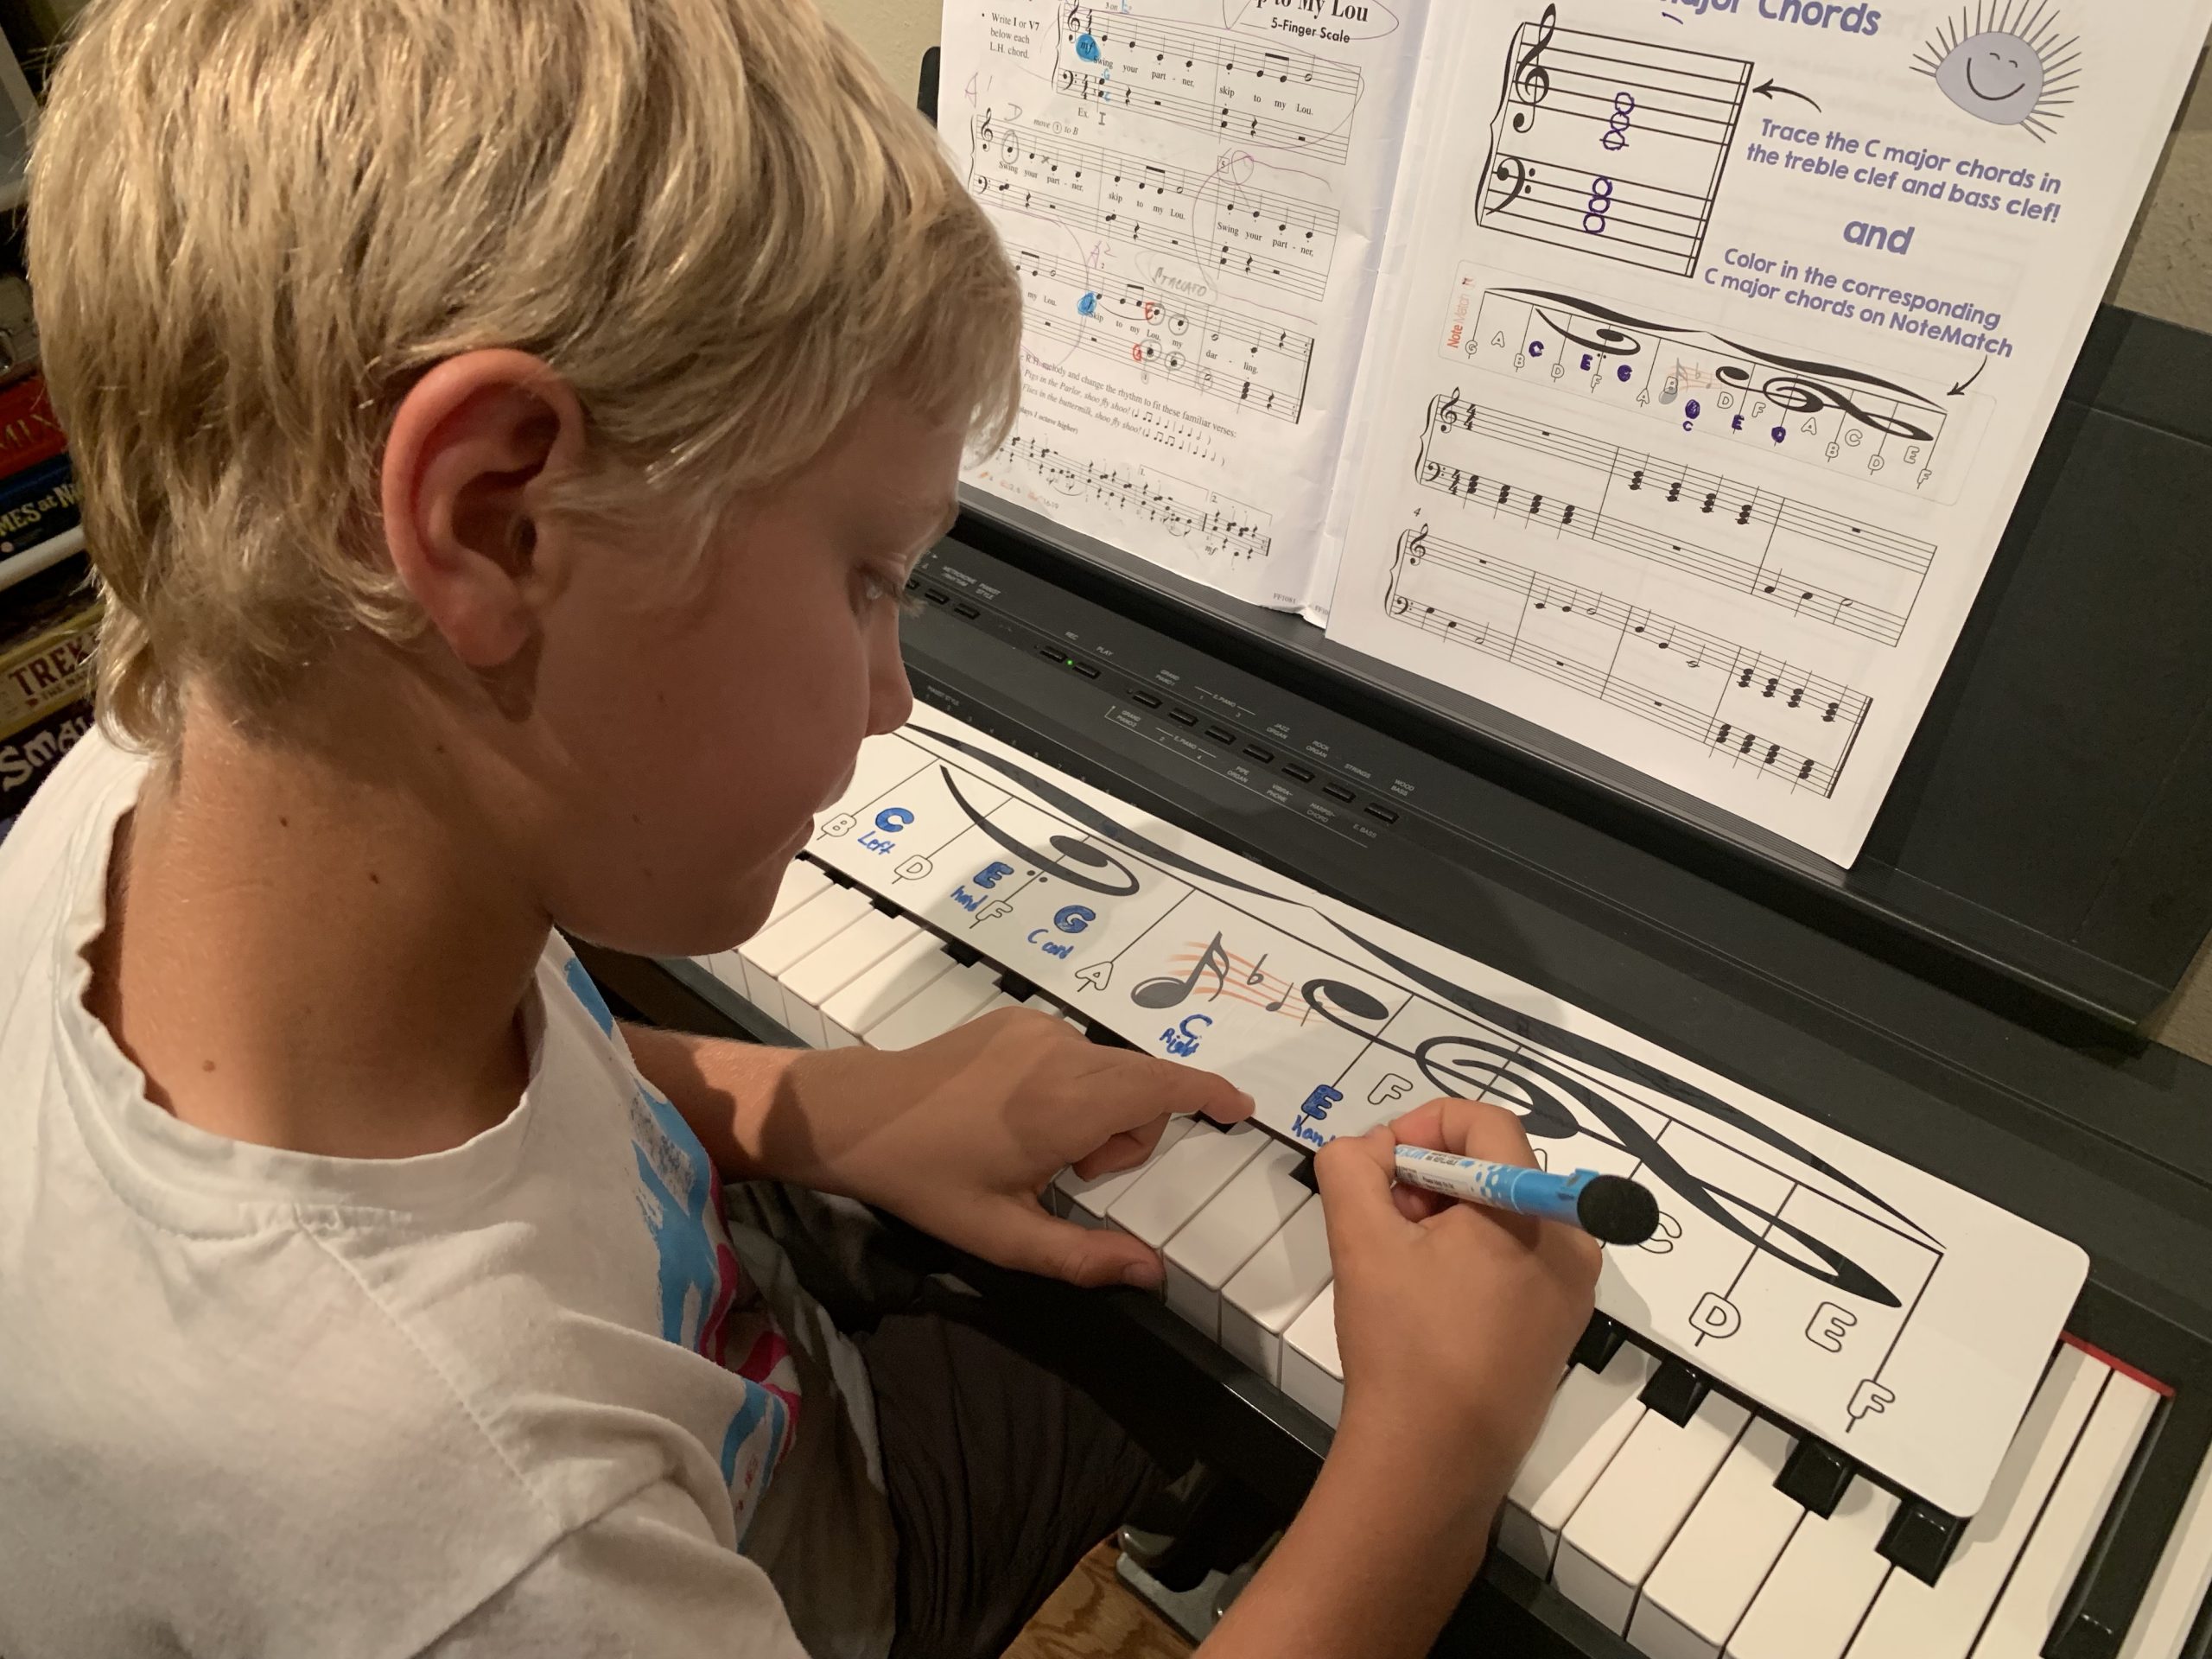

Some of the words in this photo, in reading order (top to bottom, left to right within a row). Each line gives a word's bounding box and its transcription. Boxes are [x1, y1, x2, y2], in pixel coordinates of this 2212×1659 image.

[1332, 0, 1369, 22] Lou
[992, 13, 1012, 27] Write
[1028, 21, 1039, 31] V7
[1271, 17, 1317, 37] 5-Finger
[1319, 27, 1351, 43] Scale
[990, 28, 1012, 41] below
[1014, 33, 1030, 44] each
[1007, 45, 1030, 59] chord.
[1094, 55, 1113, 68] Swing
[1123, 64, 1139, 74] your
[1152, 70, 1166, 80] part
[1220, 86, 1235, 98] skip
[1254, 94, 1262, 103] to
[1274, 99, 1287, 110] my
[1296, 104, 1313, 116] Lou.
[1033, 118, 1051, 129] move
[1065, 125, 1071, 134] to
[1762, 118, 1820, 146] Trace
[1825, 130, 1859, 155] the
[1865, 139, 1880, 158] C
[1883, 145, 1951, 172] major
[1956, 159, 2036, 189] chords
[2039, 172, 2062, 194] in
[999, 162, 1018, 175] Swing
[1024, 169, 1038, 179] your
[1047, 175, 1060, 185] part
[1109, 193, 1122, 203] skip
[1136, 200, 1144, 208] to
[1153, 206, 1163, 215] my
[1170, 208, 1185, 220] Lou.
[1746, 143, 1780, 165] the
[1784, 150, 1849, 180] treble
[1853, 167, 1899, 190] clef
[1901, 176, 1946, 200] and
[1948, 183, 2001, 212] bass
[2006, 198, 2061, 224] clef!
[1217, 221, 1239, 237] Swing
[1245, 230, 1262, 242] your
[1272, 238, 1287, 250] part
[1843, 220, 1916, 255] and
[1725, 248, 1777, 274] Color
[1780, 260, 1799, 281] in
[1804, 267, 1837, 289] the
[1842, 277, 2001, 331] corresponding
[1705, 267, 1719, 284] C
[1720, 275, 1781, 299] major
[1784, 289, 1855, 319] chords
[1859, 308, 1885, 327] on
[1889, 311, 2013, 359] NoteMatch
[1027, 291, 1037, 301] my
[1130, 325, 1140, 335] my
[1172, 339, 1183, 349] my
[1205, 349, 1217, 359] dar
[1465, 340, 1478, 355] G
[1491, 330, 1505, 347] A
[1514, 353, 1525, 368] B
[1580, 353, 1593, 371] E
[1551, 363, 1565, 378] D
[1591, 374, 1602, 388] F
[1663, 376, 1678, 395] B
[1042, 362, 1066, 378] melody
[1068, 372, 1080, 381] and
[1081, 376, 1105, 391] change
[1106, 384, 1116, 394] the
[1117, 389, 1142, 404] rhythm
[1144, 397, 1152, 407] to
[1153, 400, 1161, 411] fit
[1162, 404, 1180, 417] these
[1182, 410, 1211, 429] familiar
[1213, 423, 1237, 438] verses:
[1047, 378, 1058, 388] the
[1084, 392, 1100, 404] shoo
[1637, 387, 1650, 404] A
[1717, 391, 1734, 409] D
[1047, 393, 1058, 403] the
[1095, 411, 1111, 423] shoo
[1751, 401, 1766, 418] F
[1731, 414, 1745, 430] E
[1801, 416, 1817, 435] A
[1844, 428, 1863, 447] C
[1825, 442, 1840, 459] B
[1904, 445, 1920, 464] E
[1867, 454, 1885, 471] D
[1917, 468, 1932, 485] F
[1413, 507, 1421, 518] 4
[1096, 645, 1114, 657] PLAY
[1266, 727, 1288, 740] ORGAN
[1274, 722, 1290, 733] JAZZ
[1306, 745, 1327, 759] ORGAN
[1312, 741, 1330, 752] ROCK
[1227, 770, 1249, 783] ORGAN
[1236, 766, 1250, 776] PIPE
[1344, 763, 1371, 779] STRINGS
[1390, 785, 1408, 797] BASS
[1395, 779, 1414, 791] WOOD
[1266, 789, 1288, 803] PHONE
[821, 812, 858, 838] B
[874, 807, 915, 833] C
[1306, 810, 1330, 823] CHORD
[1362, 827, 1377, 838] BASS
[893, 855, 933, 880] D
[973, 861, 1014, 889] E
[976, 899, 1014, 921] F
[1053, 905, 1096, 934] G
[1027, 929, 1049, 944] C
[1075, 961, 1114, 991] A
[1179, 1014, 1212, 1040] C
[1367, 1073, 1414, 1105] F
[1300, 1084, 1344, 1121] E
[1688, 1292, 1741, 1338] D
[1805, 1301, 1858, 1353] E
[1847, 1378, 1895, 1420] F
